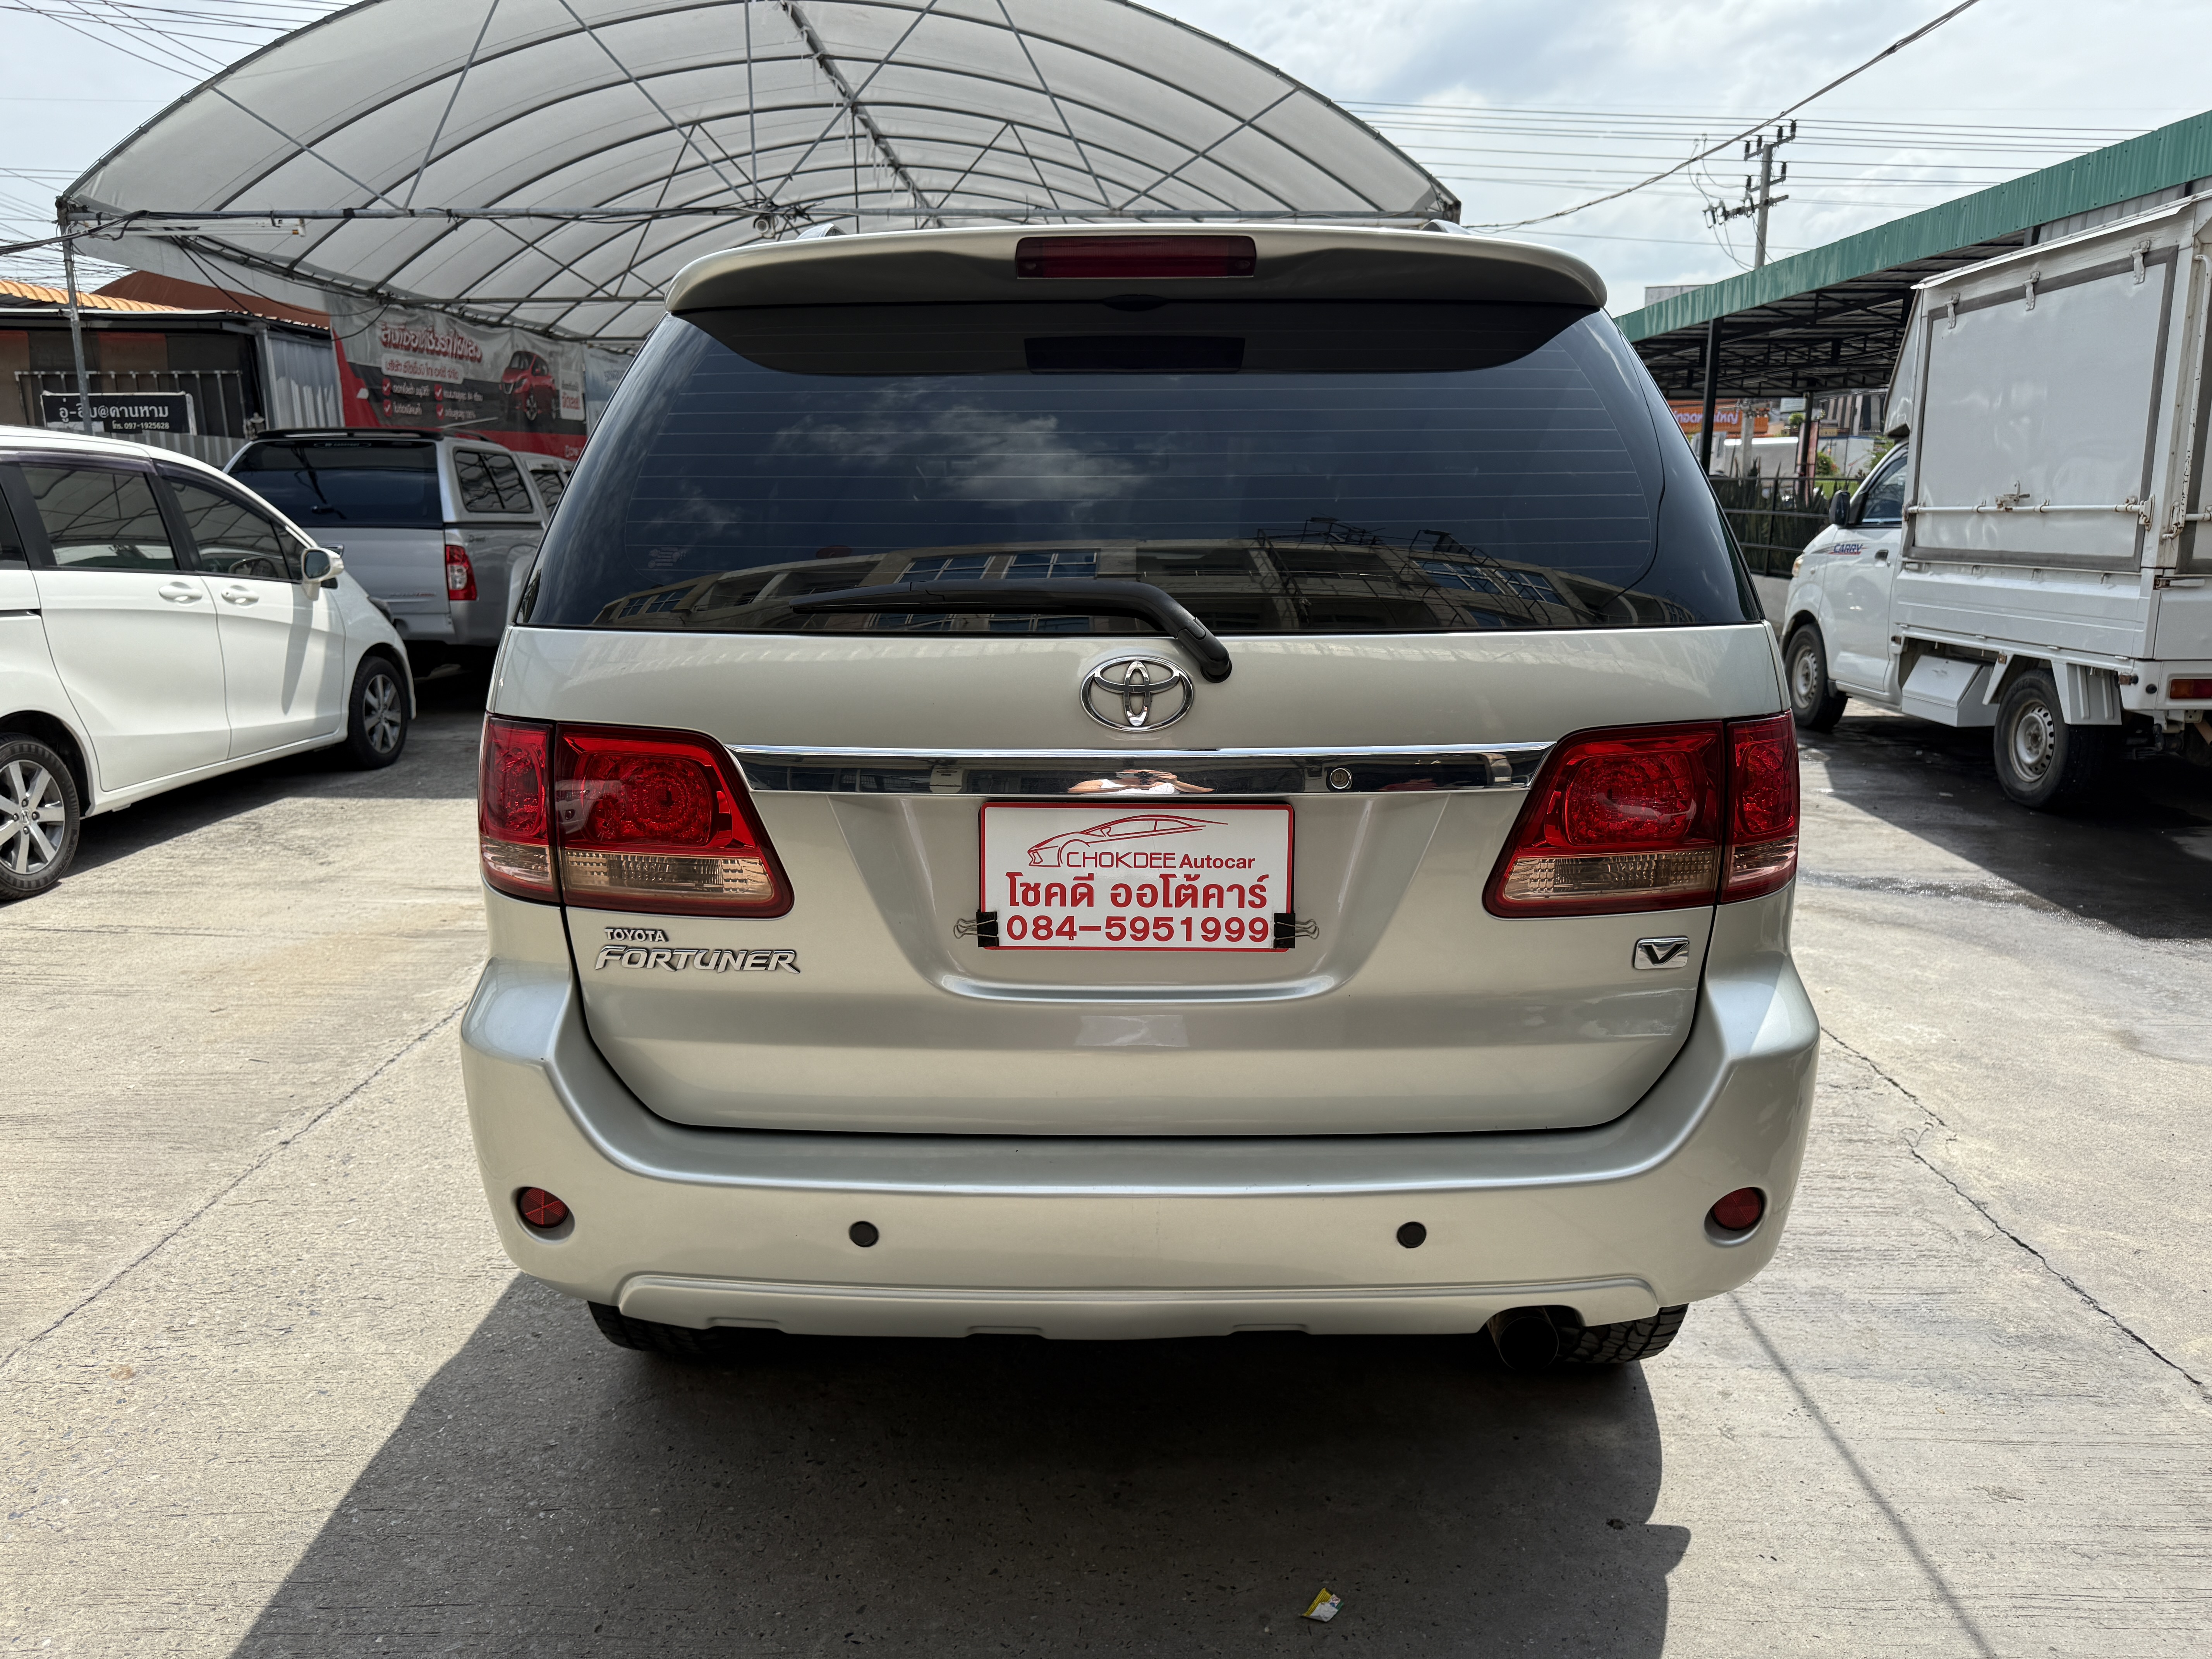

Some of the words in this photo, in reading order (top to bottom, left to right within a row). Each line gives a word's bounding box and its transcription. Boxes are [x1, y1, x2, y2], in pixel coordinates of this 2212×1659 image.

[1833, 543, 1863, 553] CARRY
[1066, 851, 1176, 869] CHOKDEE
[1179, 854, 1255, 869] Autocar
[1005, 872, 1095, 908] โชคดี
[1110, 873, 1269, 909] ออโต้คาร์
[604, 927, 669, 942] TOYOTA
[1006, 915, 1269, 943] 084-5951999
[595, 945, 800, 974] FORTUNER
